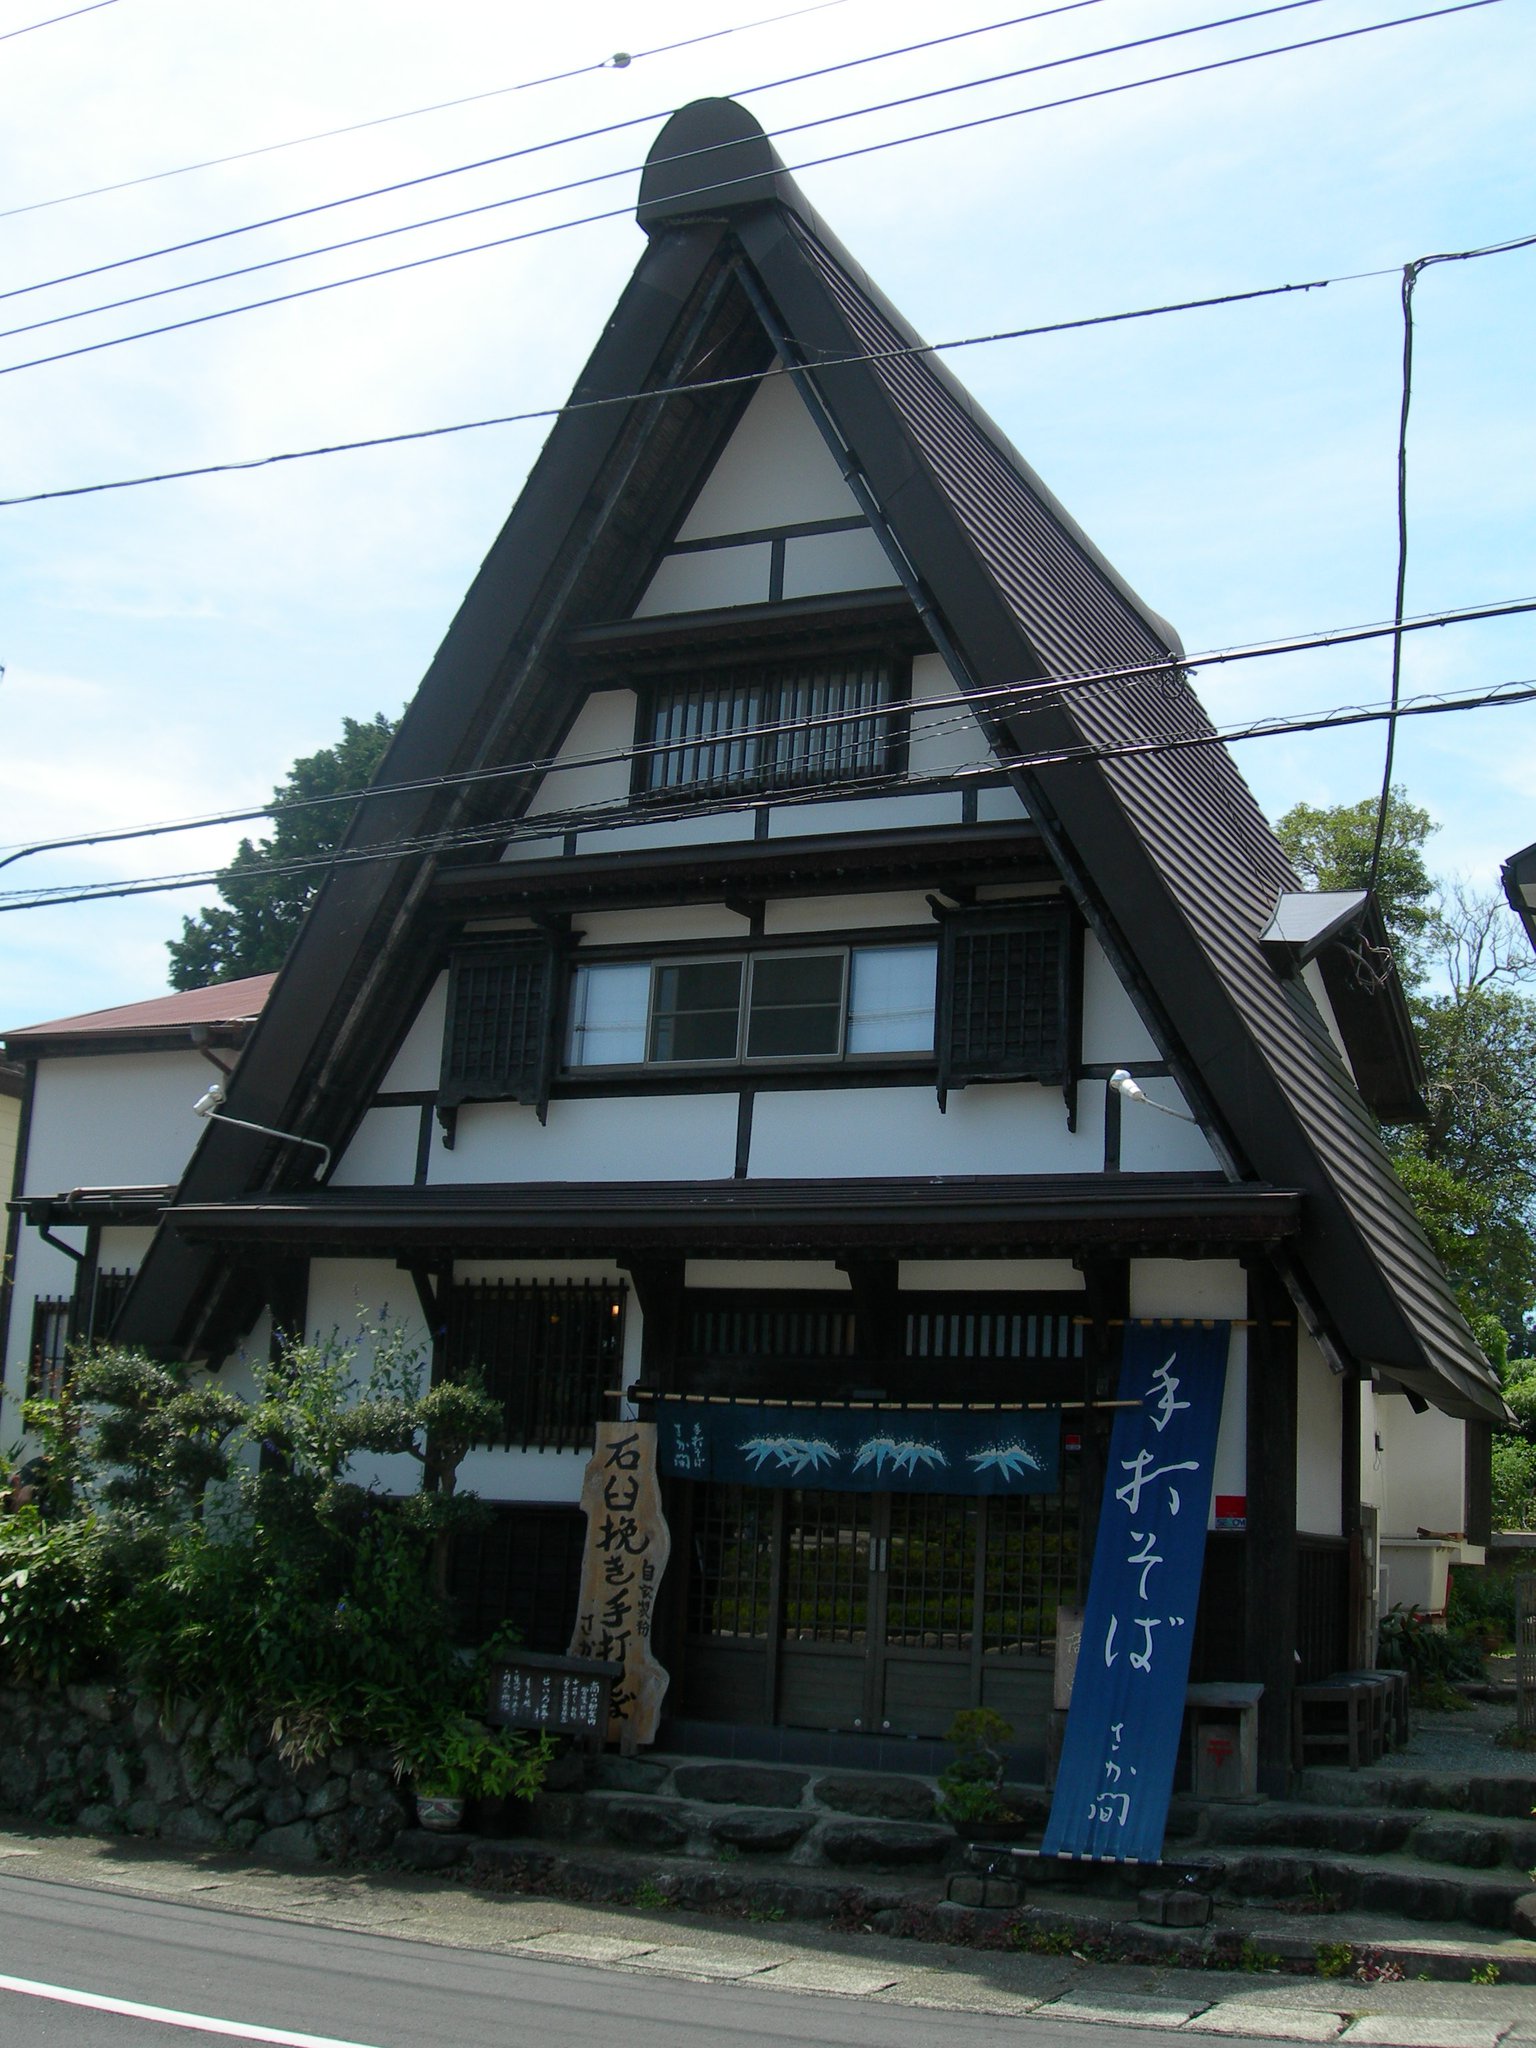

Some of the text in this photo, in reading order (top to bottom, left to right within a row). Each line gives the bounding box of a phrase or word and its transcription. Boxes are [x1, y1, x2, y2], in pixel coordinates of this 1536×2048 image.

[637, 1560, 656, 1637] 自家製粉
[1104, 1351, 1199, 1674] 手打そば
